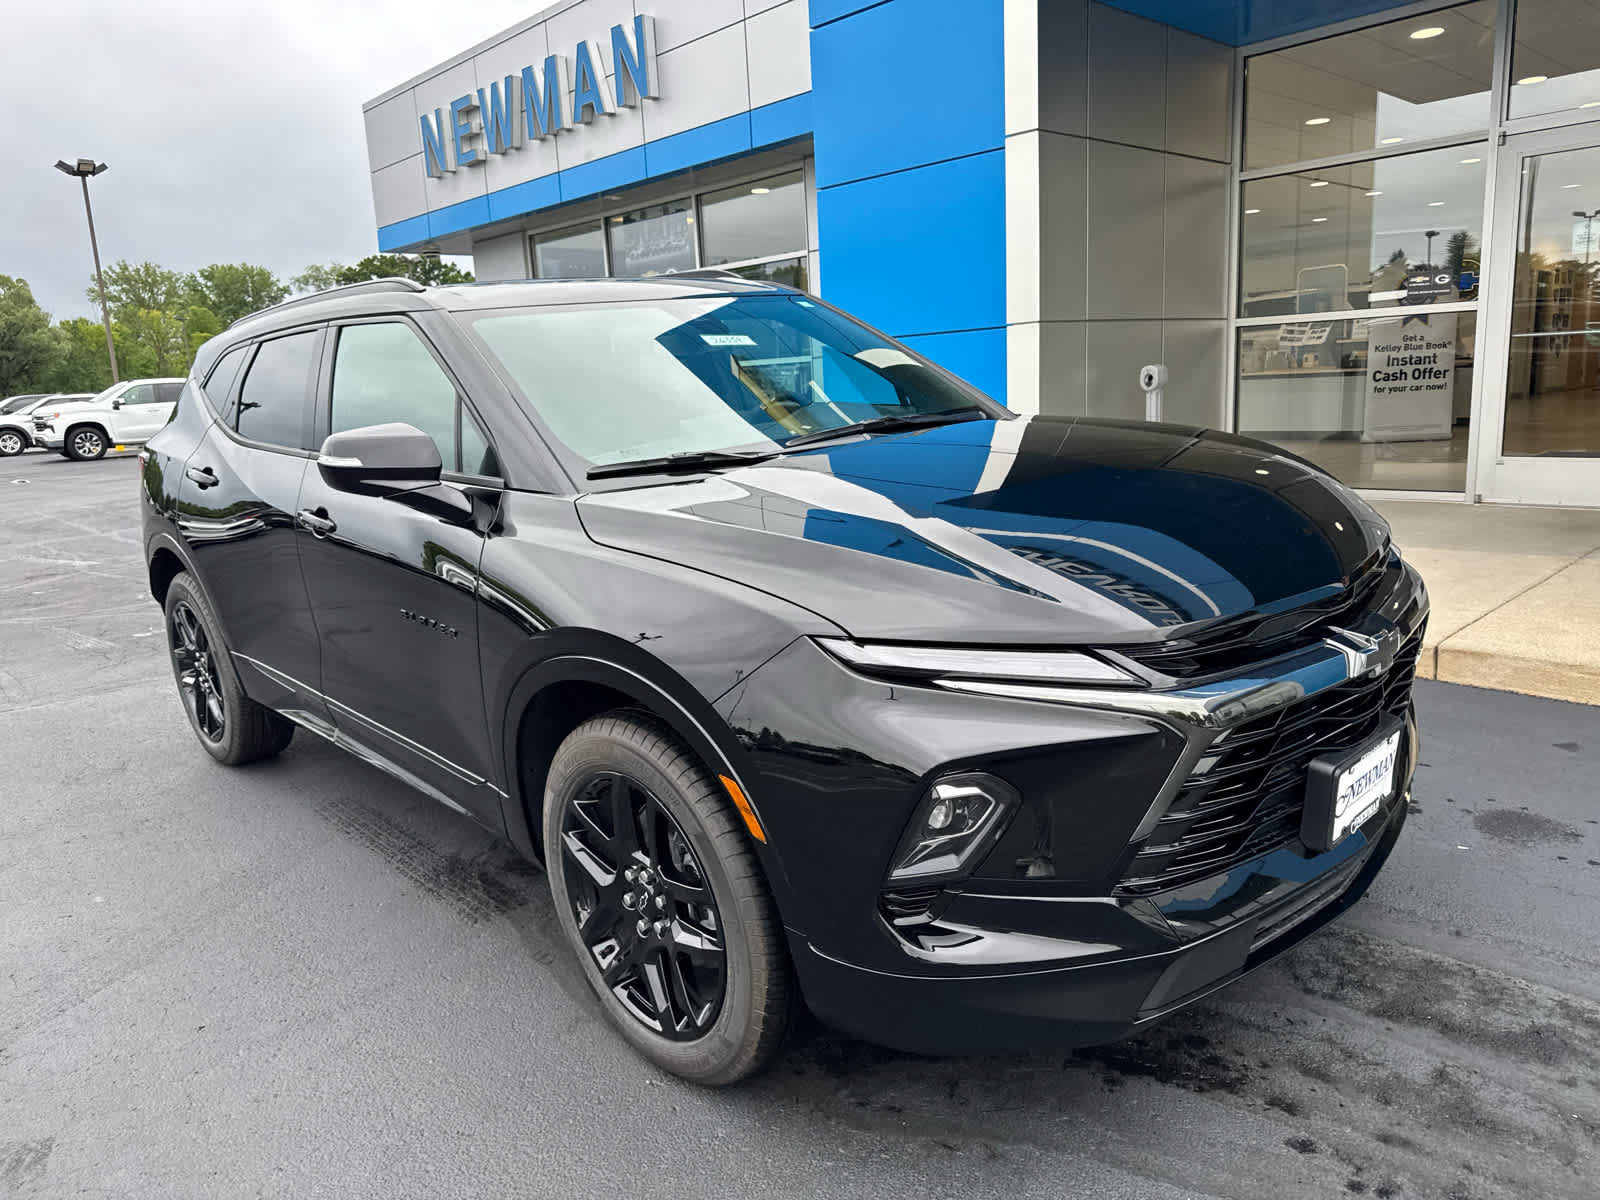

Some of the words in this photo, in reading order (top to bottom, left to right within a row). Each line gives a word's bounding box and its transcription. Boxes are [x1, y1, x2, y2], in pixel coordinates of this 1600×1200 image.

[420, 15, 660, 178] NEWMAN
[1402, 334, 1417, 342] Get
[1374, 344, 1401, 353] Kelley
[1403, 343, 1424, 351] Blue
[1386, 352, 1438, 367] Instant
[1372, 368, 1408, 382] Cash
[1411, 367, 1449, 380] Offer
[1374, 385, 1386, 393] for
[1387, 385, 1408, 395] your
[1425, 382, 1447, 391] now!
[1349, 753, 1395, 799] NEWMAN
